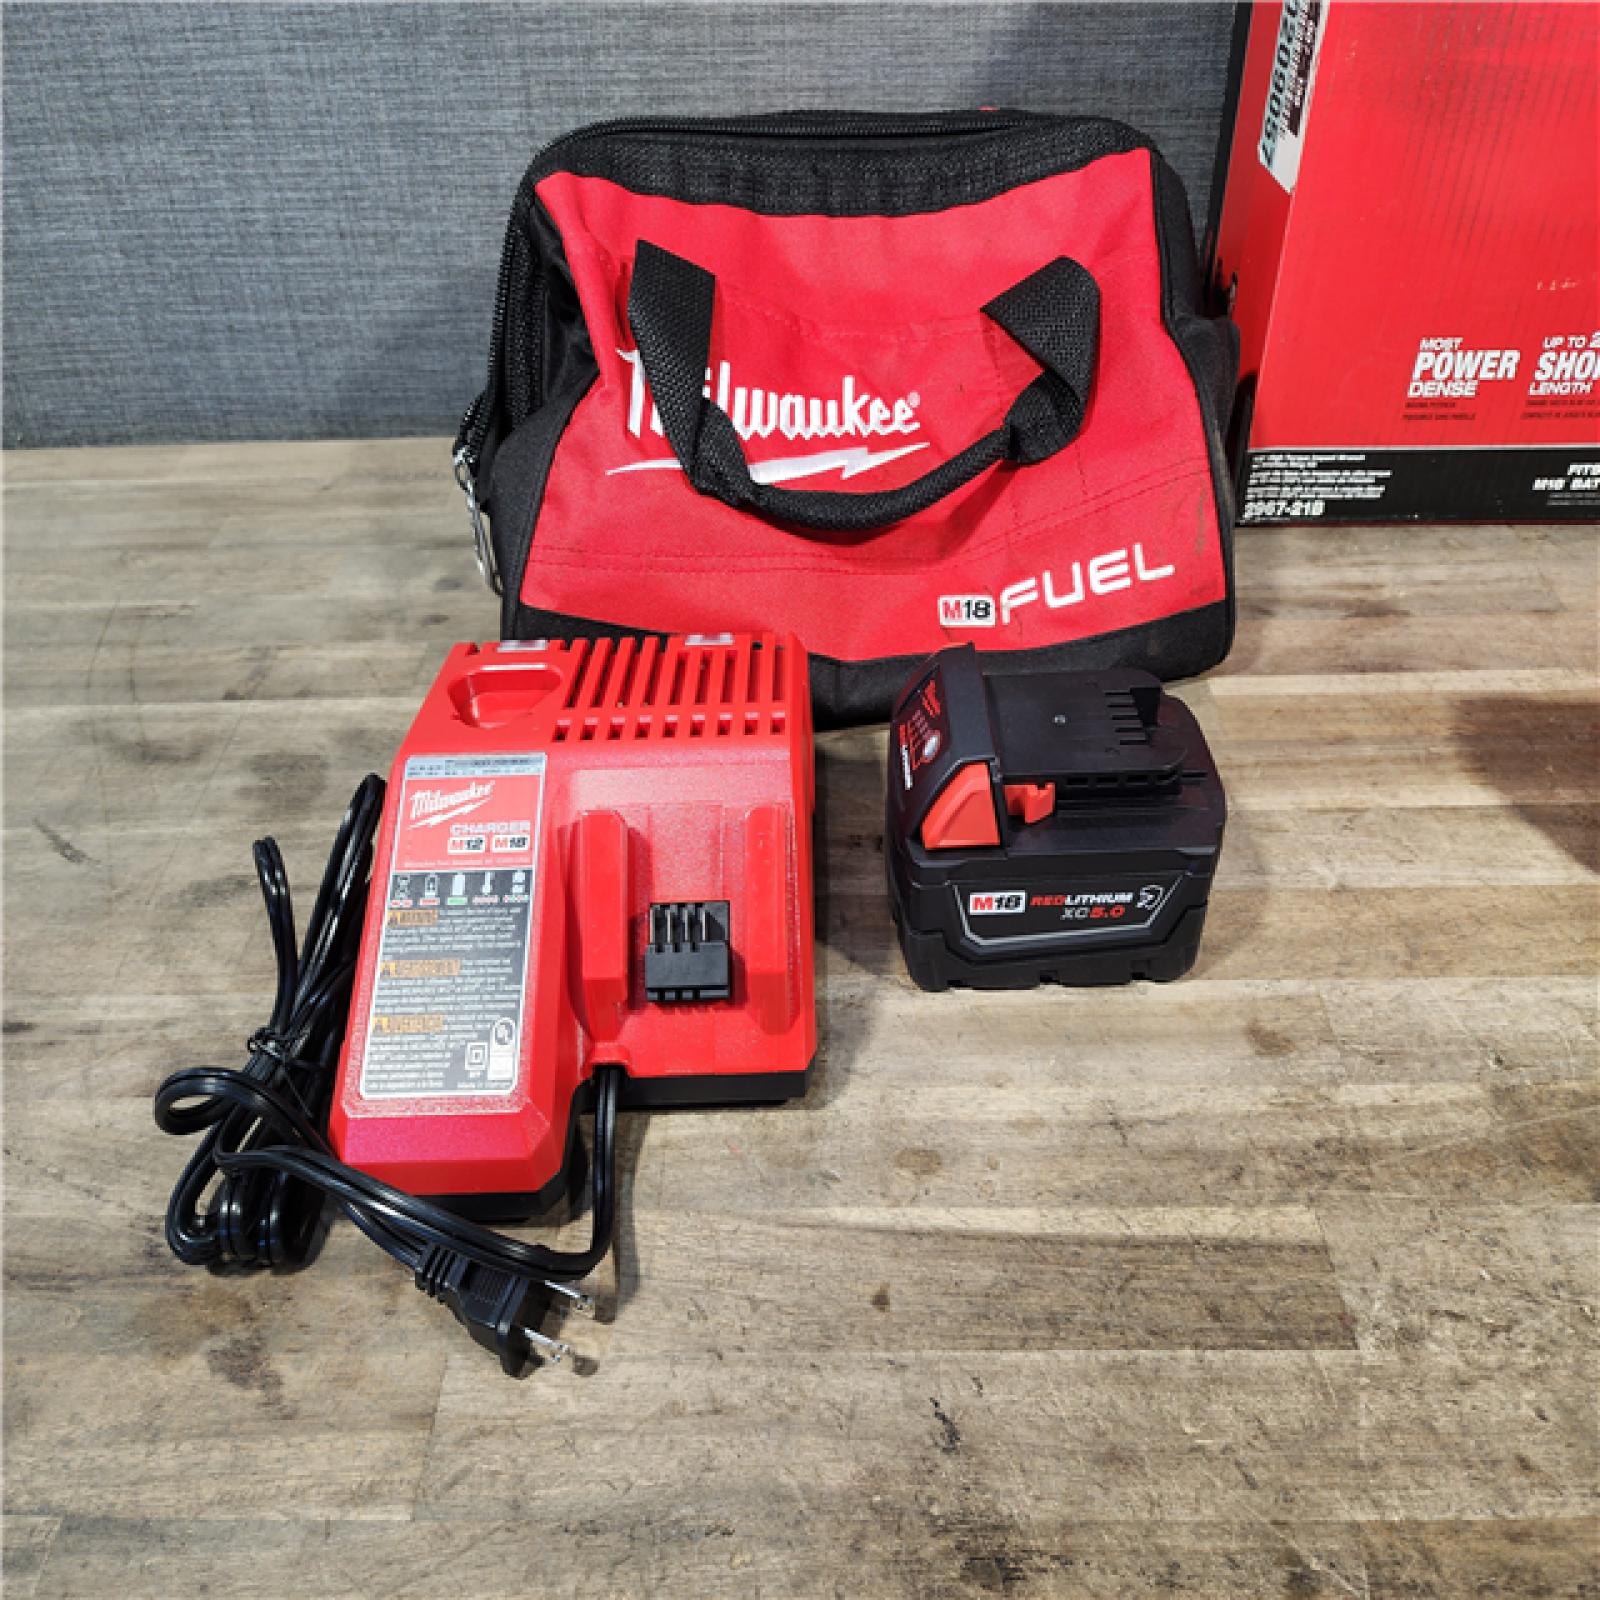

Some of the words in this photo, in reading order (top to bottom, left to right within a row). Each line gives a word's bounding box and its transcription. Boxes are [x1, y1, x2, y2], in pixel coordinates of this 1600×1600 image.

[1420, 337, 1463, 350] MOST
[1543, 336, 1565, 348] UP
[1567, 336, 1587, 348] TO
[1412, 350, 1521, 380] POWER
[616, 349, 921, 441] lwaukee
[1407, 380, 1479, 397] DENSE
[1528, 381, 1593, 396] LENGTH
[942, 599, 991, 620] M18
[1000, 543, 1175, 625] FUEL
[409, 781, 493, 821] Milwaukee
[971, 893, 1021, 912] M18
